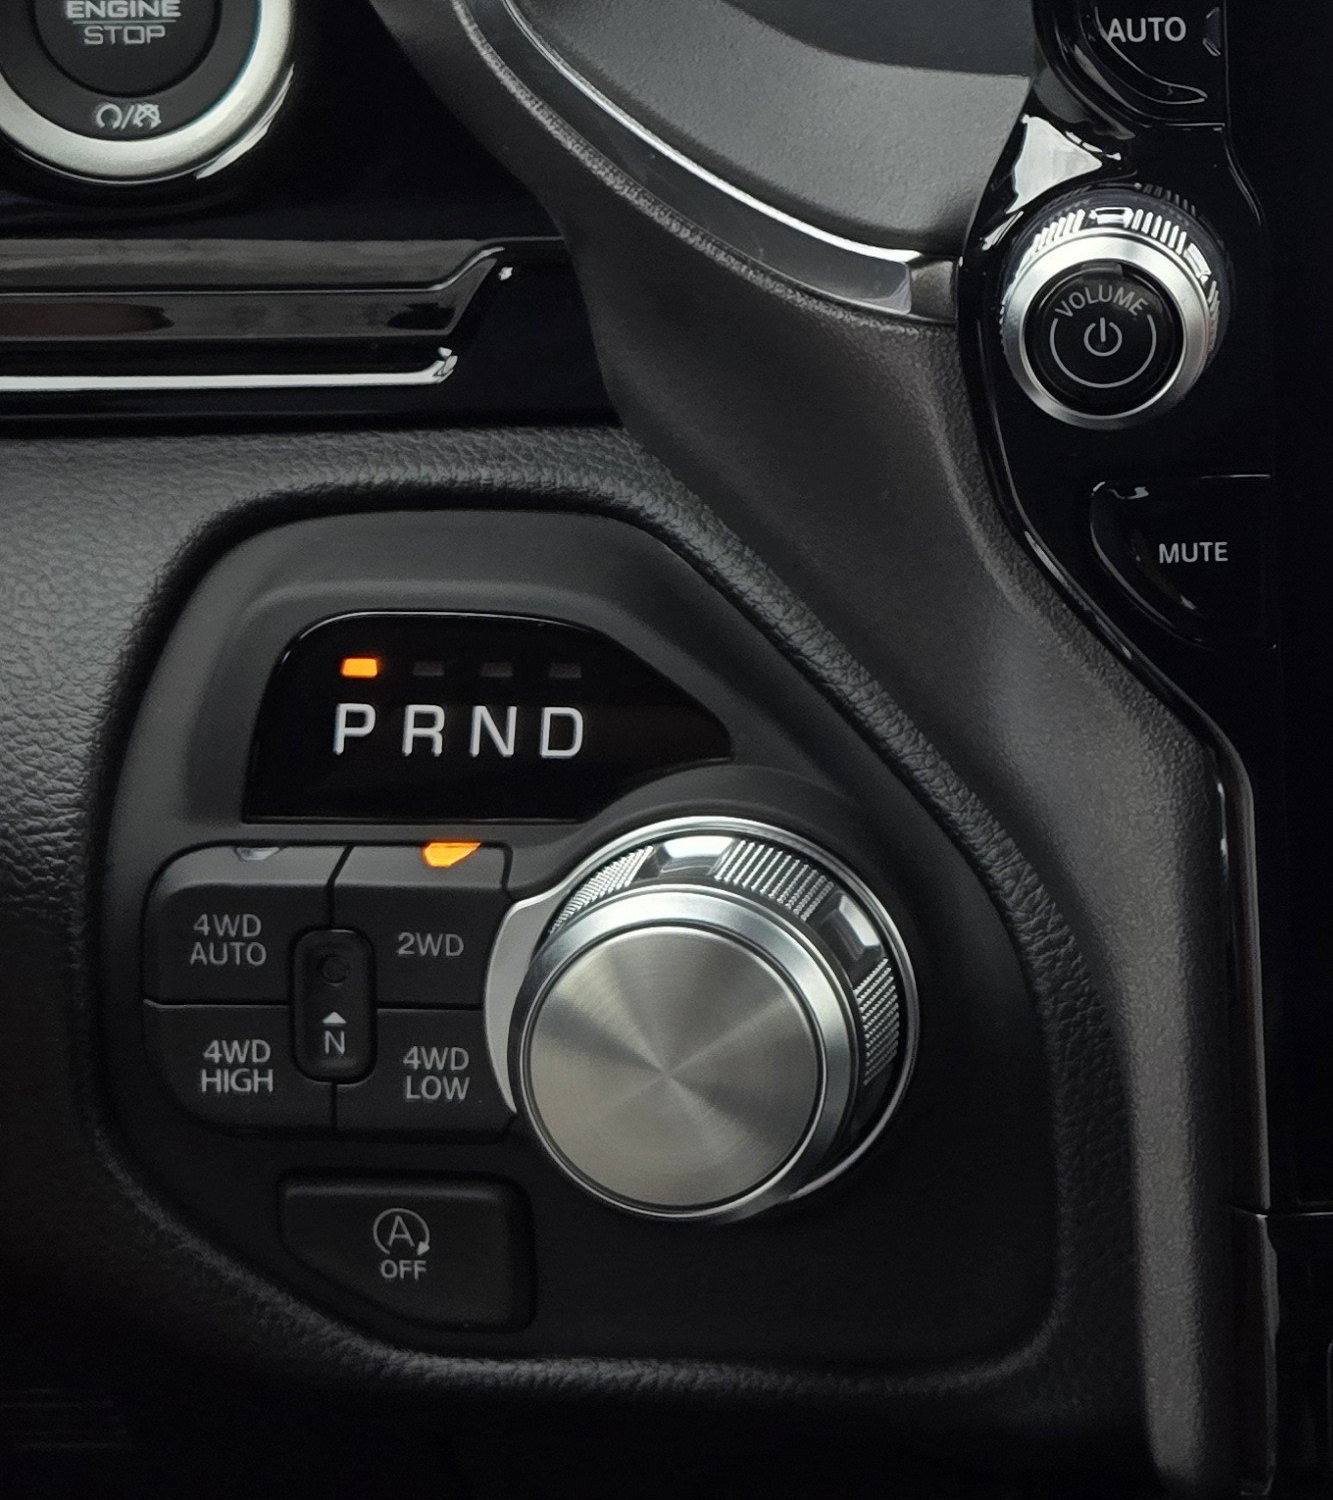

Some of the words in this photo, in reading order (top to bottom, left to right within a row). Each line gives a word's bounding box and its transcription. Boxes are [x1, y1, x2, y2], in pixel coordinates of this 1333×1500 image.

[66, 0, 182, 19] ENGINE
[83, 25, 167, 45] STOP
[1108, 16, 1186, 43] AUTO
[1053, 285, 1150, 320] VOLUME
[1159, 541, 1229, 564] MUTE
[333, 703, 376, 756] P
[402, 705, 444, 757] R
[469, 706, 517, 757] N
[539, 706, 585, 758] D
[193, 913, 262, 939] 4WD
[189, 941, 267, 966] AUTO
[396, 932, 465, 957] 2WD
[203, 1039, 271, 1064] 4WD
[325, 1032, 346, 1055] N
[402, 1046, 470, 1071] 4WD
[200, 1067, 274, 1093] HIGH
[406, 1075, 470, 1100] LOW
[380, 1260, 427, 1280] OFF
